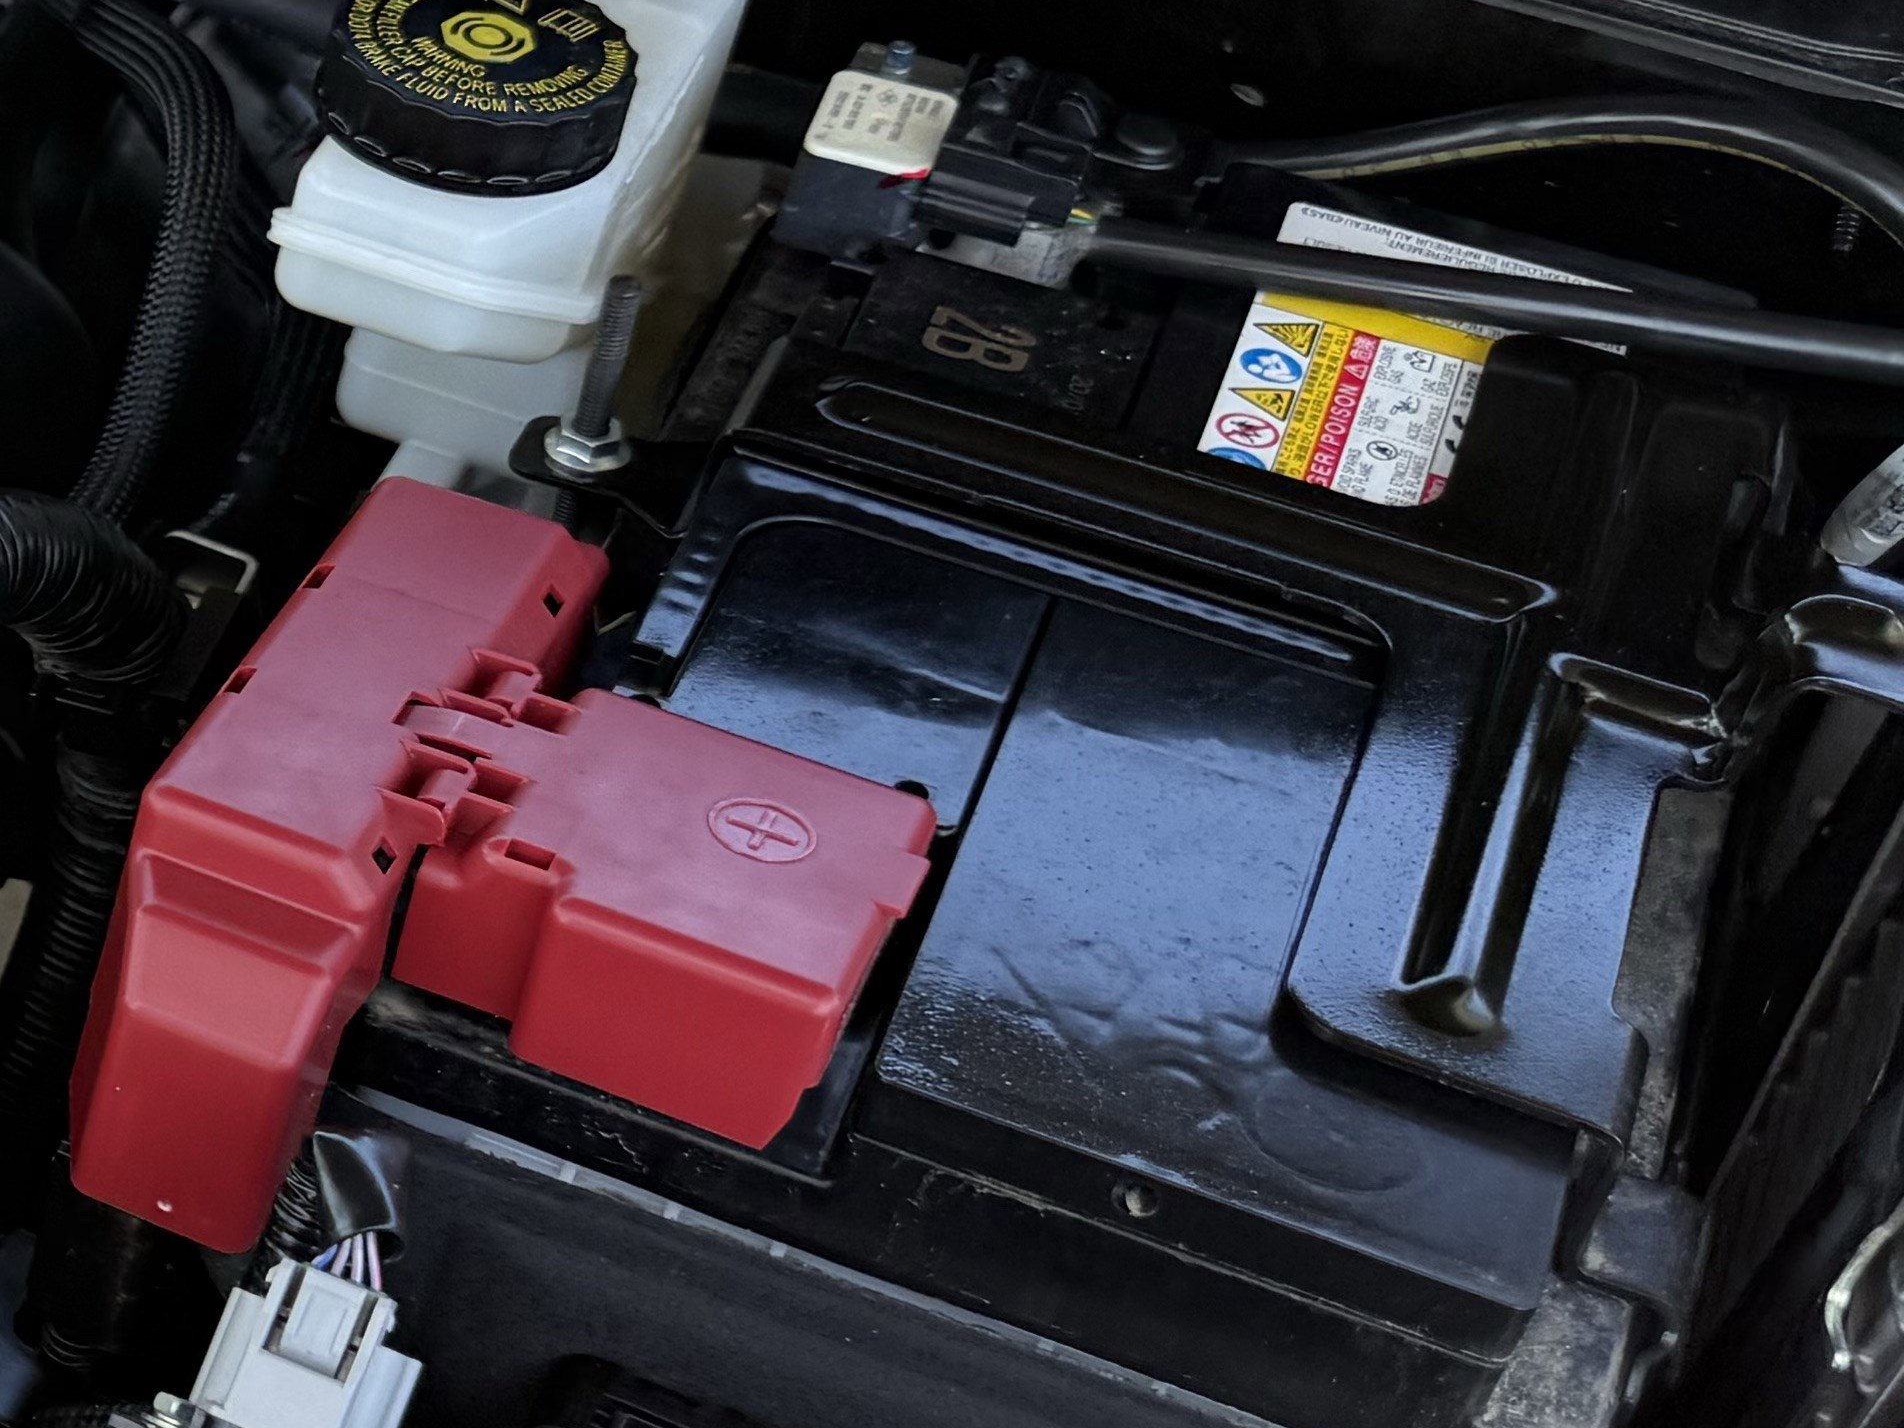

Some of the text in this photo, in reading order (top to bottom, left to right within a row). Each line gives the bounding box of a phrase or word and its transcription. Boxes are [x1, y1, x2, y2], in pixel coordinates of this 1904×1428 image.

[354, 41, 403, 77] BRAKE
[395, 72, 450, 101] FLUID
[452, 92, 508, 113] FROM
[514, 100, 528, 113] A
[529, 87, 597, 113] SEALED
[591, 39, 629, 94] CONTAINER
[391, 46, 428, 67] CAP
[420, 65, 497, 96] BEFORE
[502, 64, 590, 97] REMOVING
[410, 36, 487, 78] WARNING
